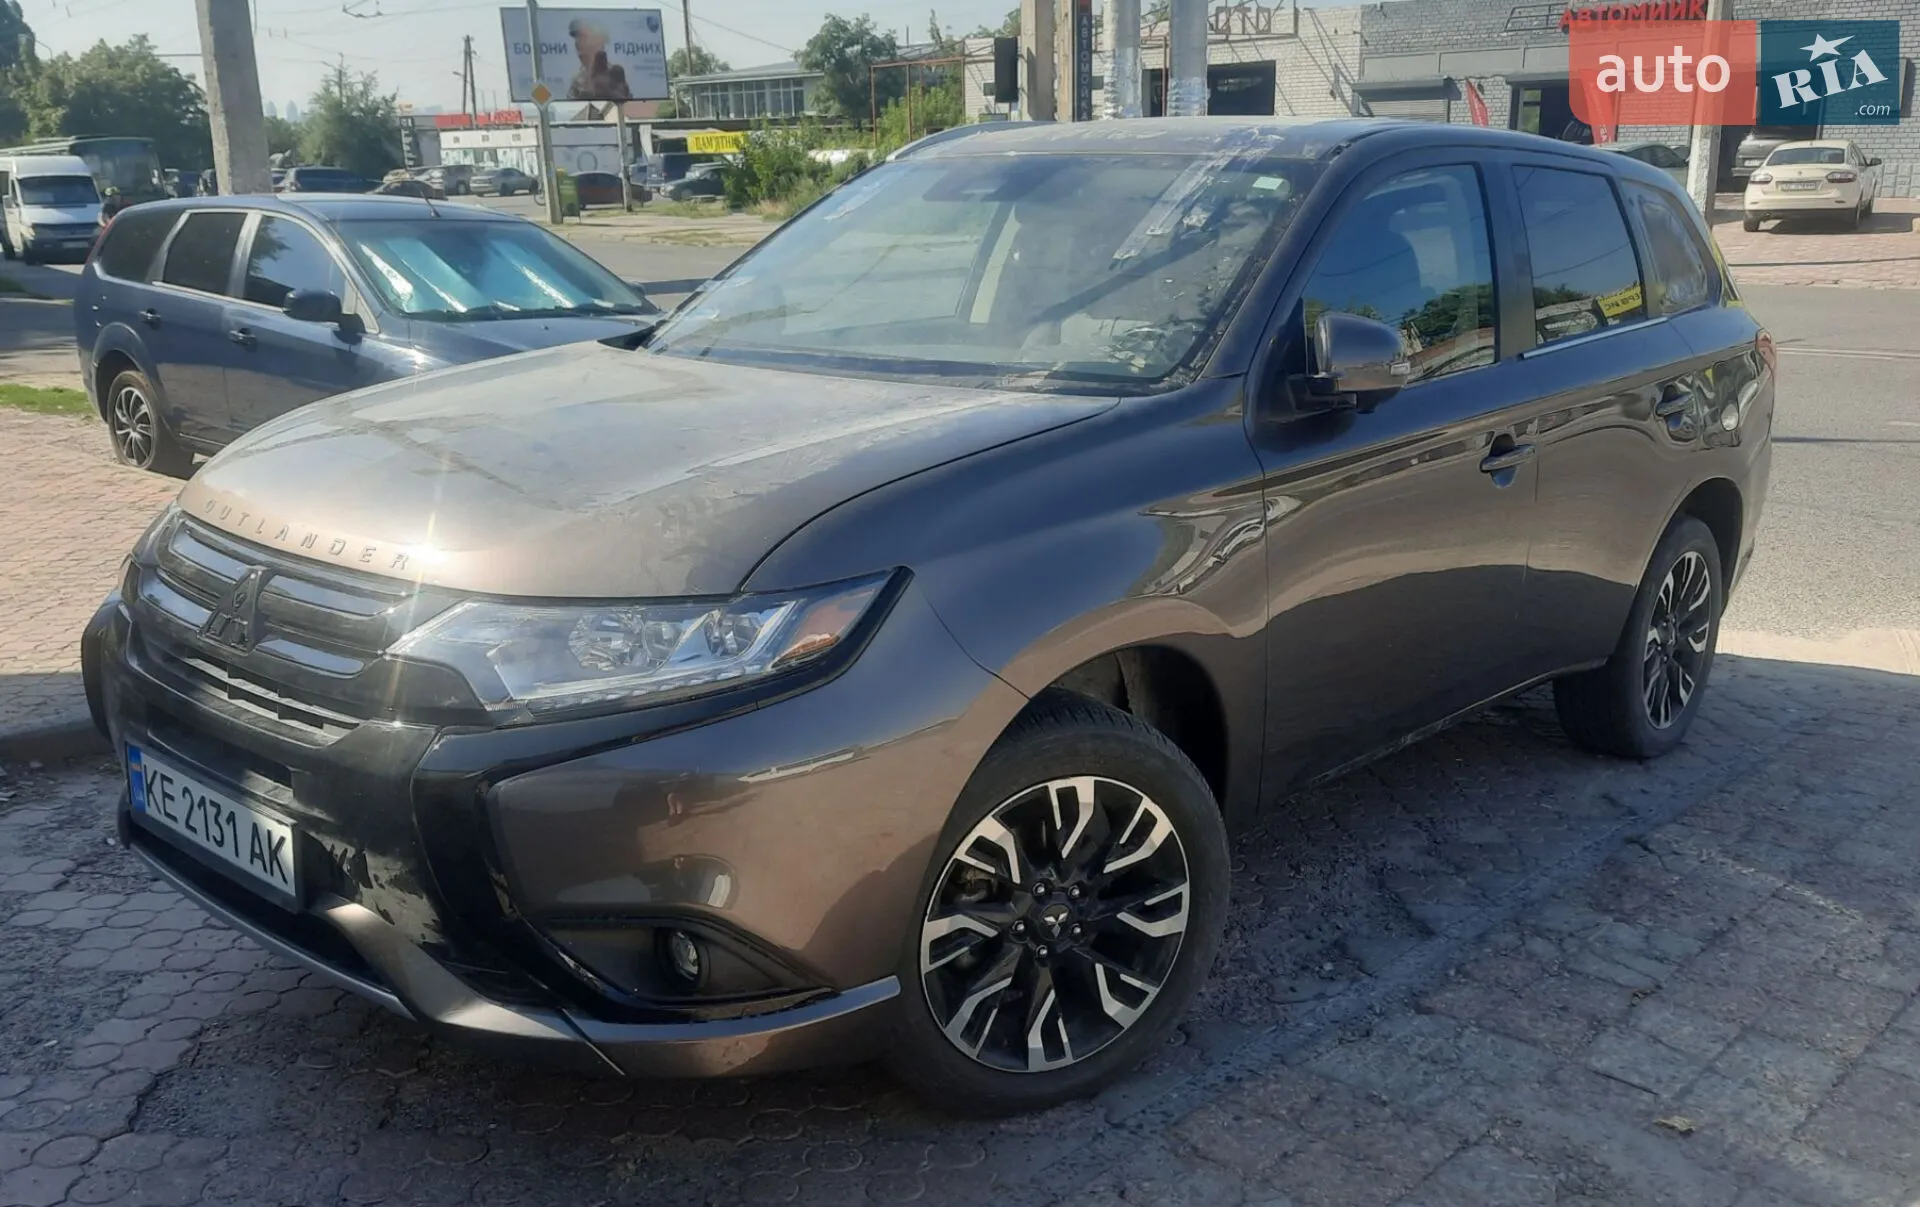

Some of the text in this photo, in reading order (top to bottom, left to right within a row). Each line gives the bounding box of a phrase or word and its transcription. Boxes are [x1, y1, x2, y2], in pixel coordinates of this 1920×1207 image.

[513, 42, 662, 57] БООНИ РІДНИХ
[203, 498, 411, 571] OUTLANDER
